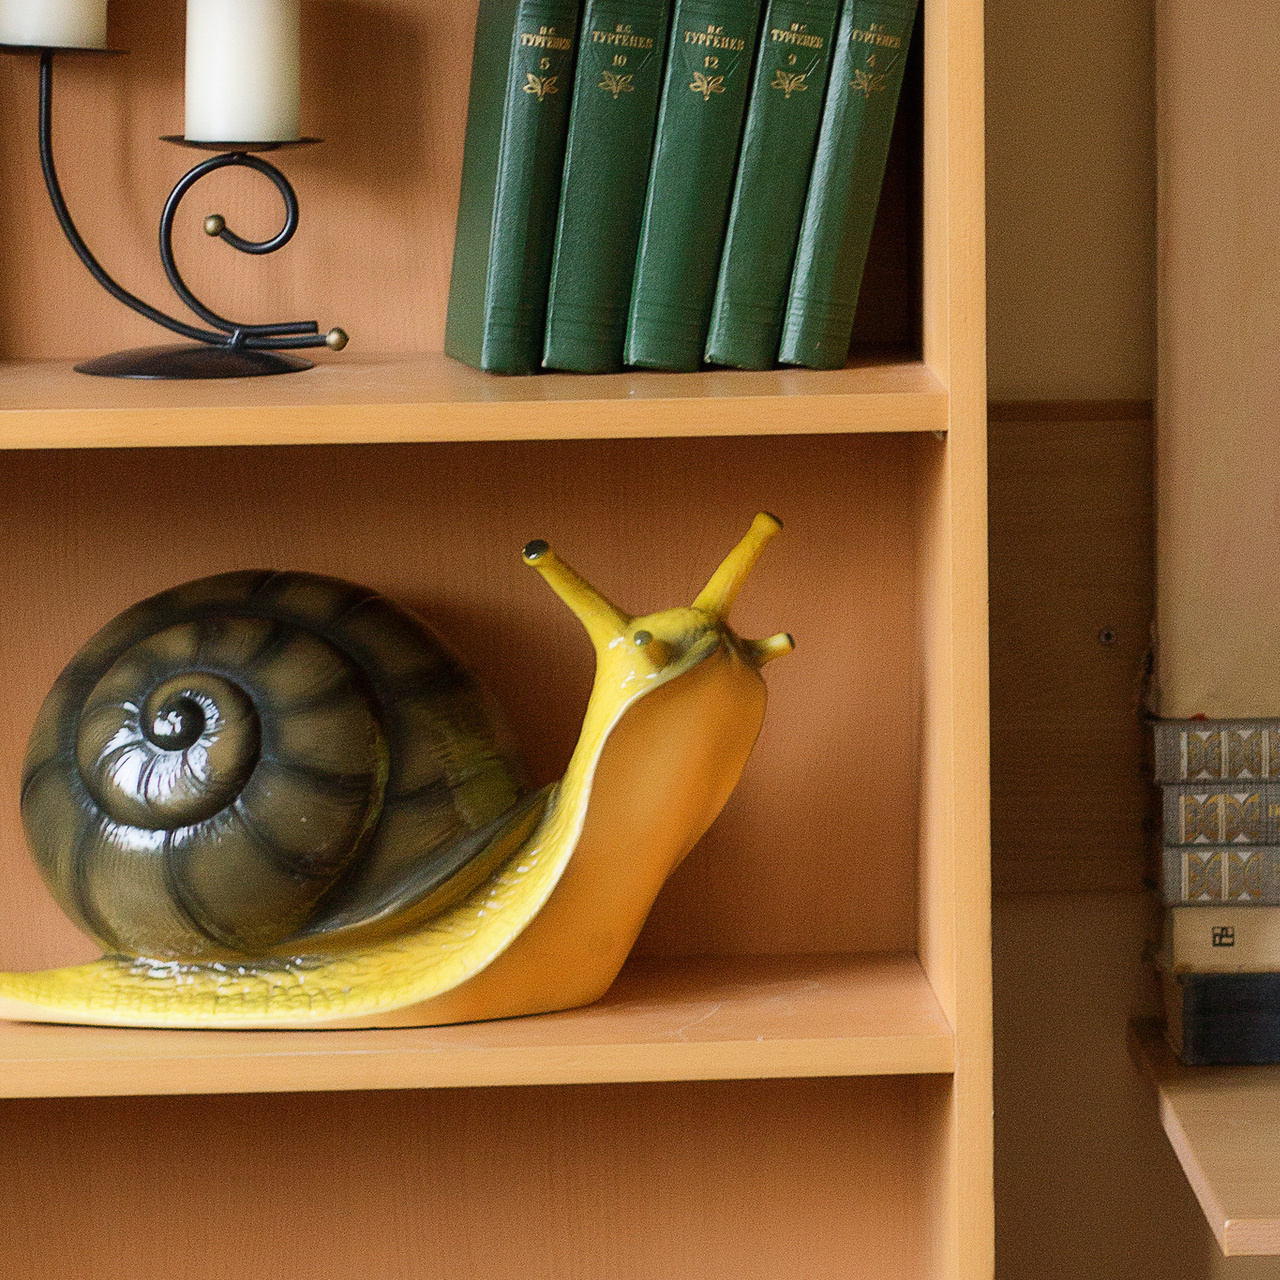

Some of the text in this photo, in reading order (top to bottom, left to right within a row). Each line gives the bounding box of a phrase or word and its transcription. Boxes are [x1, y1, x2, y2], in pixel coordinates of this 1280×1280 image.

[521, 33, 571, 51] ТУРГЕНЕВ
[592, 31, 653, 49] ТУРГЕНЕВ
[684, 31, 745, 50] ТУРГЕНЕВ
[770, 28, 824, 49] ТУРГЕНЕВ
[851, 29, 902, 49] ТУРГЕНЕВ
[539, 57, 551, 70] 5
[612, 54, 627, 67] 10
[703, 56, 719, 69] 12
[788, 53, 797, 66] 9
